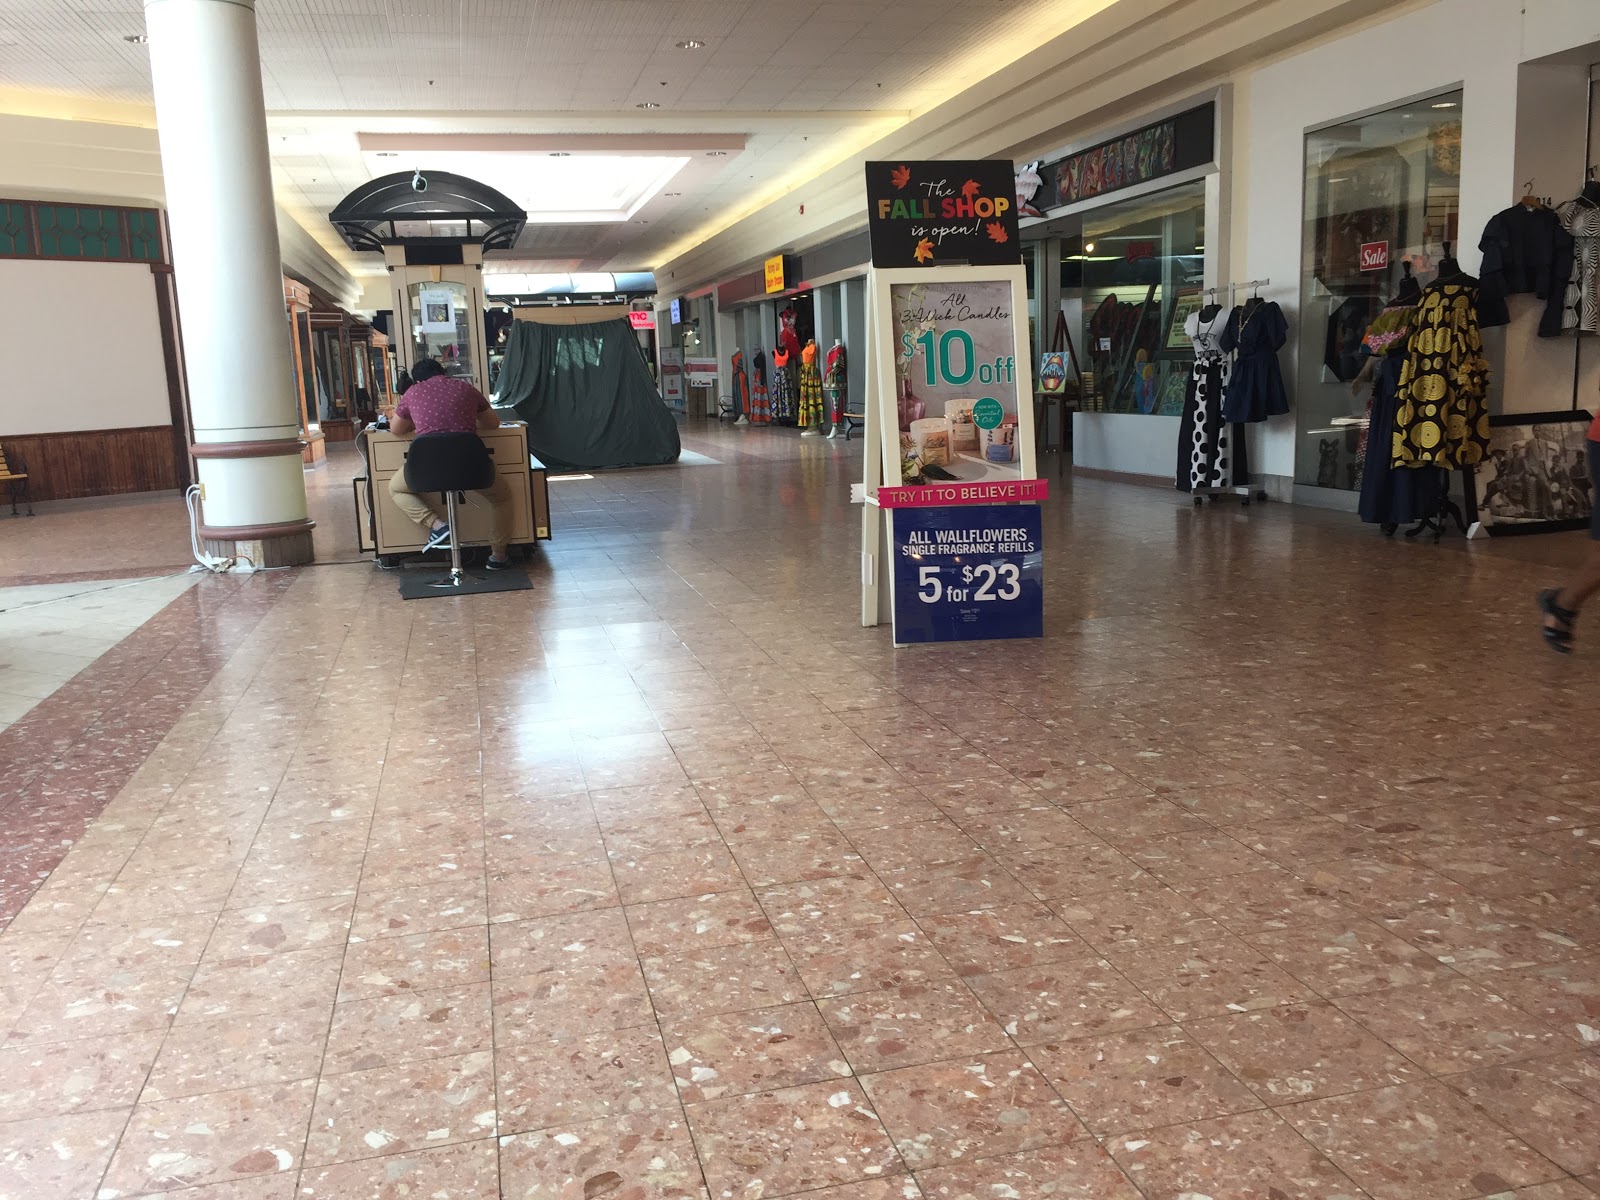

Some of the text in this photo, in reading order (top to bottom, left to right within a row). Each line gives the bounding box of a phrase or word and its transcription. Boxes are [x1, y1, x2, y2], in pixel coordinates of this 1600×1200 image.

[920, 179, 955, 197] The
[878, 197, 1010, 220] FALL SHOP
[911, 219, 980, 245] is open!
[1362, 248, 1386, 266] Sale
[940, 293, 966, 307] All
[957, 306, 1011, 321] Candles
[902, 328, 1015, 387] $10 off
[890, 484, 1037, 503] TRY IT TO BELIEVE IT!
[908, 528, 1027, 545] ALL WALLFLOWERS
[902, 541, 1035, 556] SINGLE FRAGRANCE REFILLS
[918, 563, 1021, 604] 5 for $23
